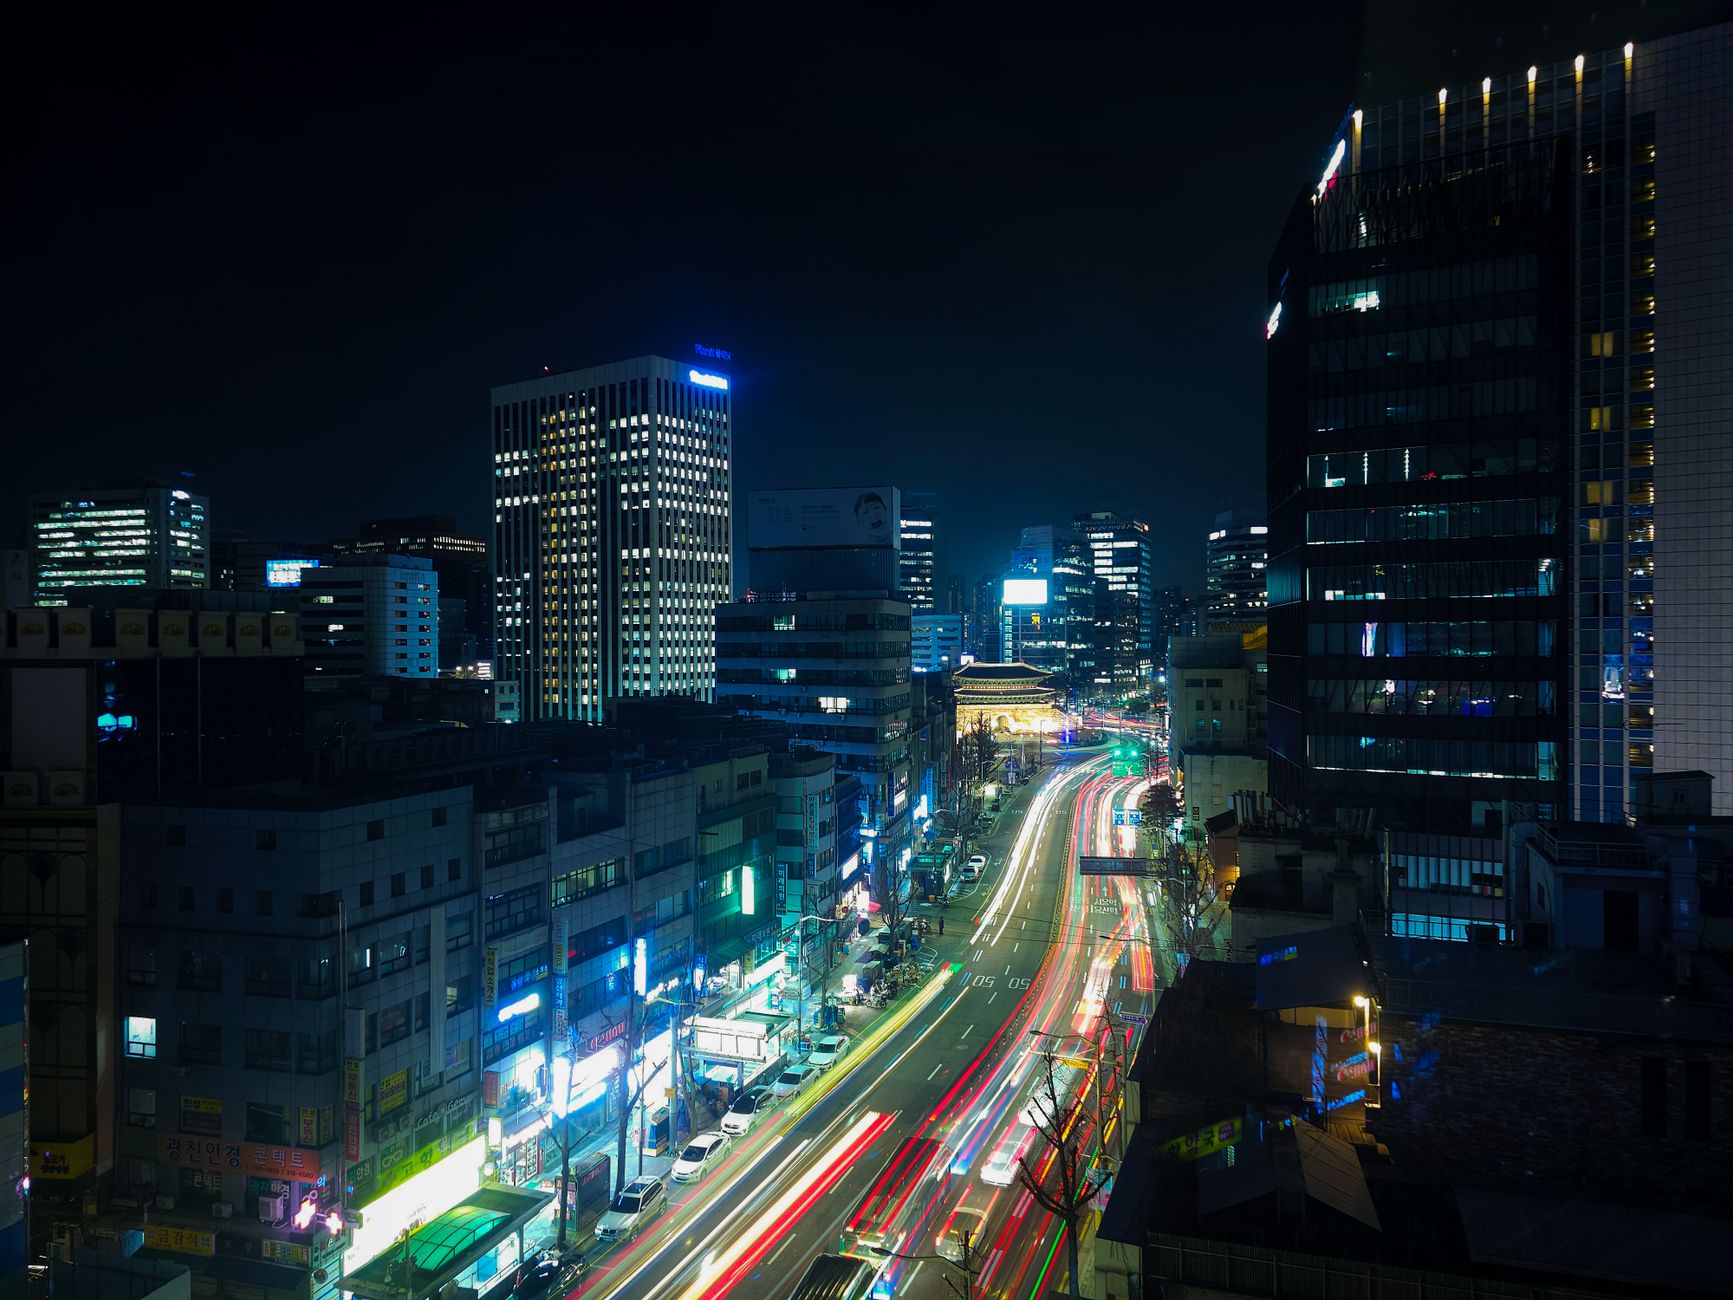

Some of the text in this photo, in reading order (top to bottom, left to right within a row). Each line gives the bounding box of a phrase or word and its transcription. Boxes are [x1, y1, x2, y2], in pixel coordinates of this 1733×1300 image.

[1008, 977, 1031, 990] 50
[166, 1137, 304, 1169] 광진안경 콘택트
